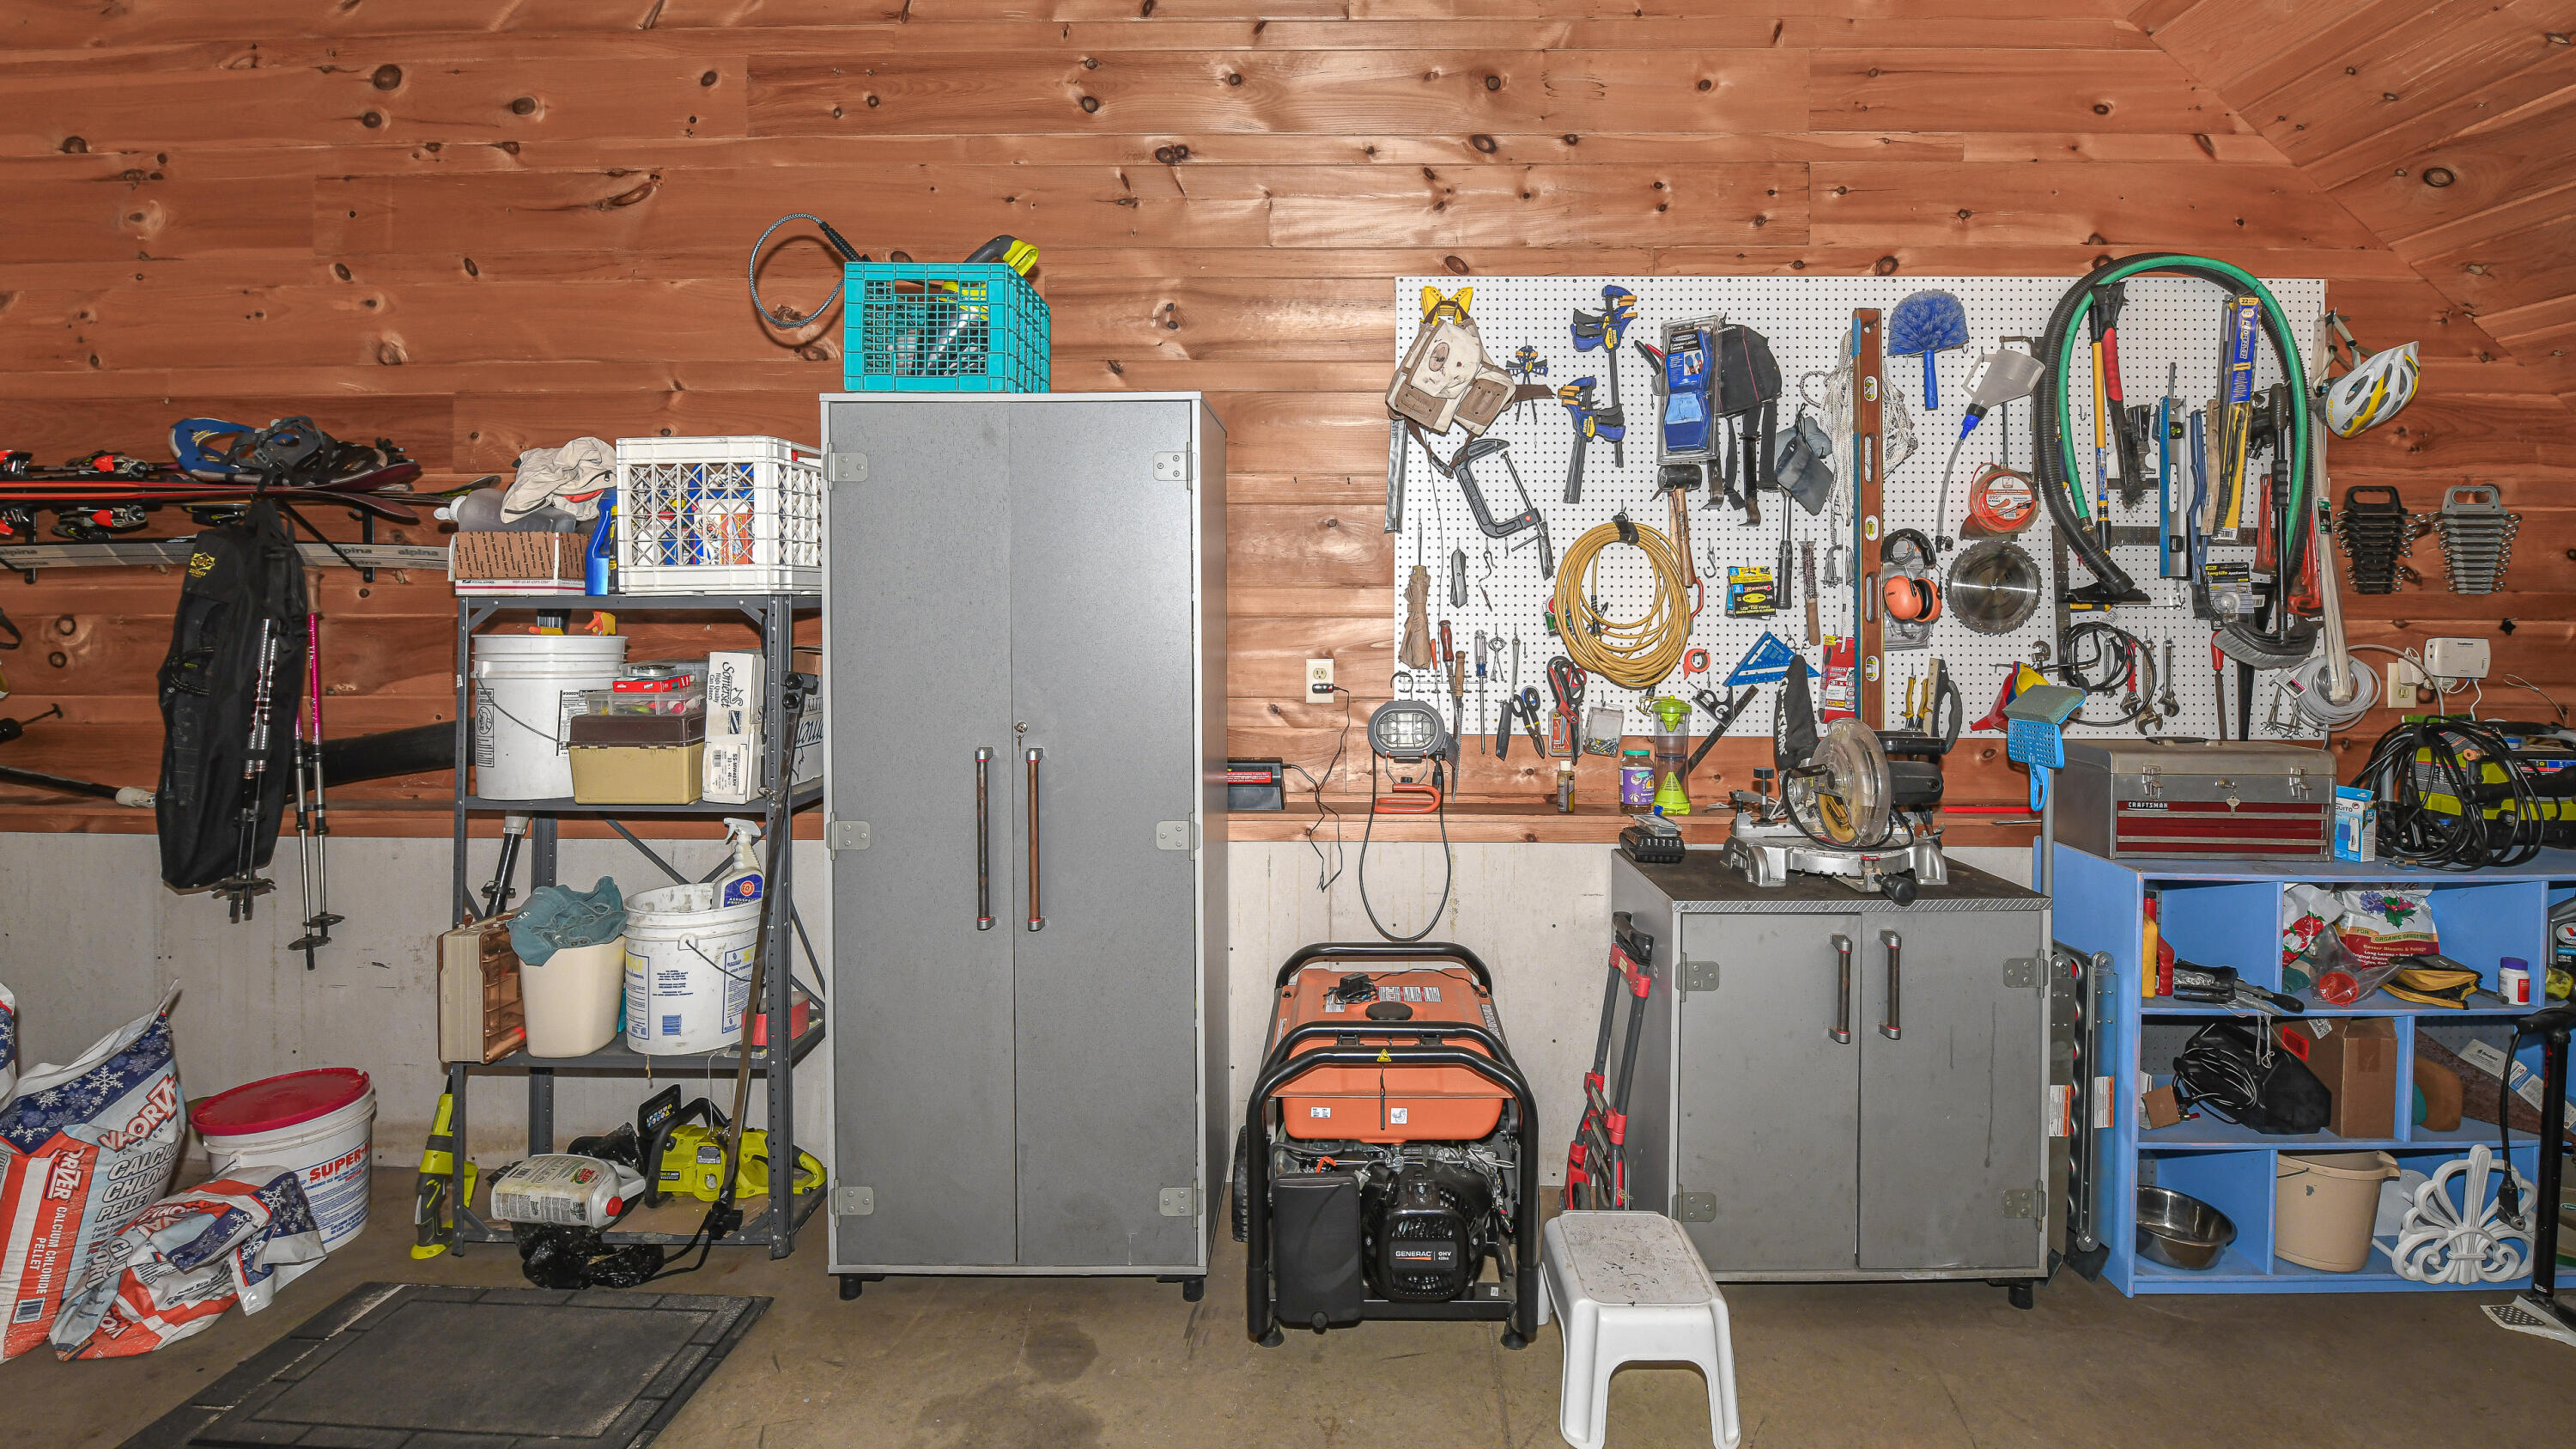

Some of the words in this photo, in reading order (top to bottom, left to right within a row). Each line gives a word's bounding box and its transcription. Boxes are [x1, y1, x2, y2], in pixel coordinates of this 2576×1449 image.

[398, 548, 439, 557] alpina
[721, 661, 734, 709] Somerset
[52, 1148, 83, 1201] ORIZER
[102, 1161, 173, 1202] CHLOR
[107, 1143, 179, 1181] CALCIU
[95, 1187, 155, 1223] PELLET
[47, 1206, 68, 1248] CALCIUM
[29, 1237, 47, 1271] PELLET
[36, 1250, 57, 1294] CHLORIDE
